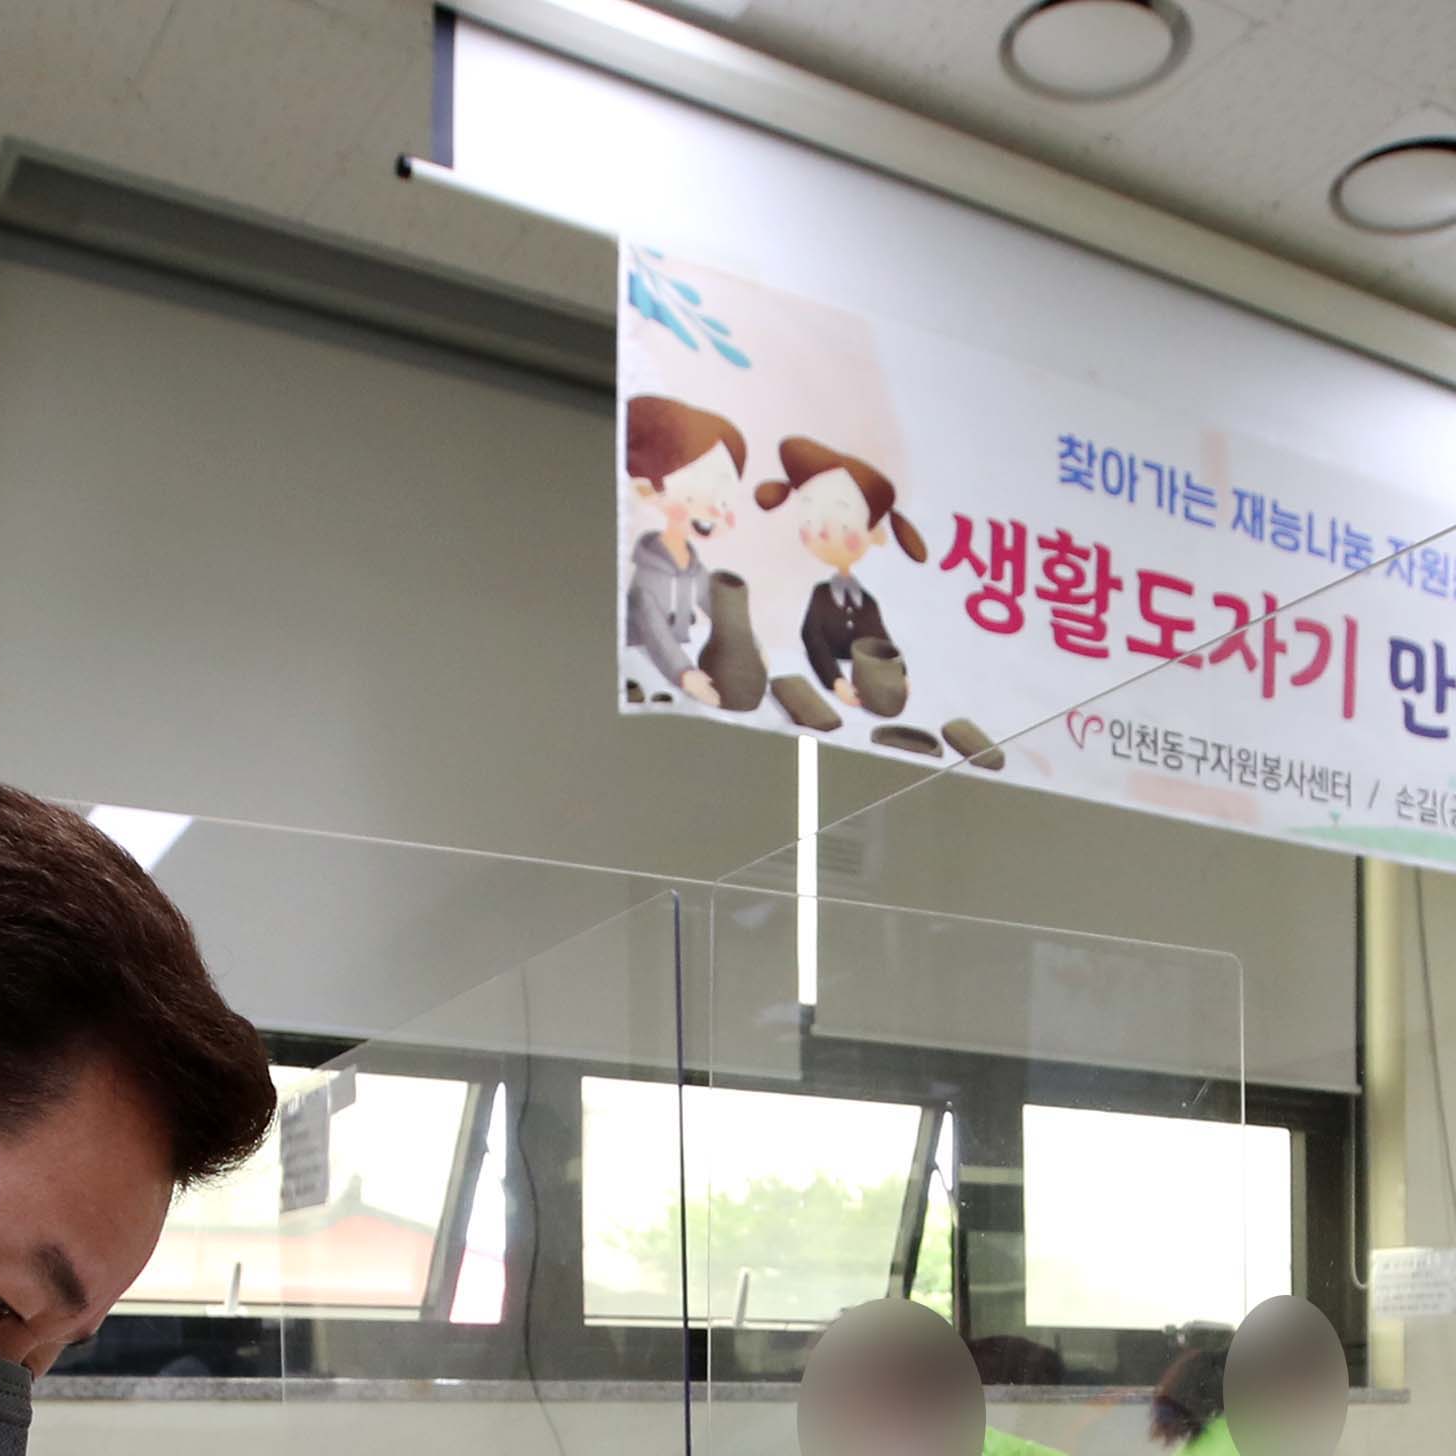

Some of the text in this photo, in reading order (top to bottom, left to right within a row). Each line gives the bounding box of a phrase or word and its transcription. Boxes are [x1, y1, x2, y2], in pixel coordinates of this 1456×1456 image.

[1057, 432, 1219, 530] 찾아가는
[1229, 486, 1375, 574] 재능나눔
[939, 511, 1358, 721] 생활도자기
[1109, 717, 1353, 809] 인천동구자원봉사센터
